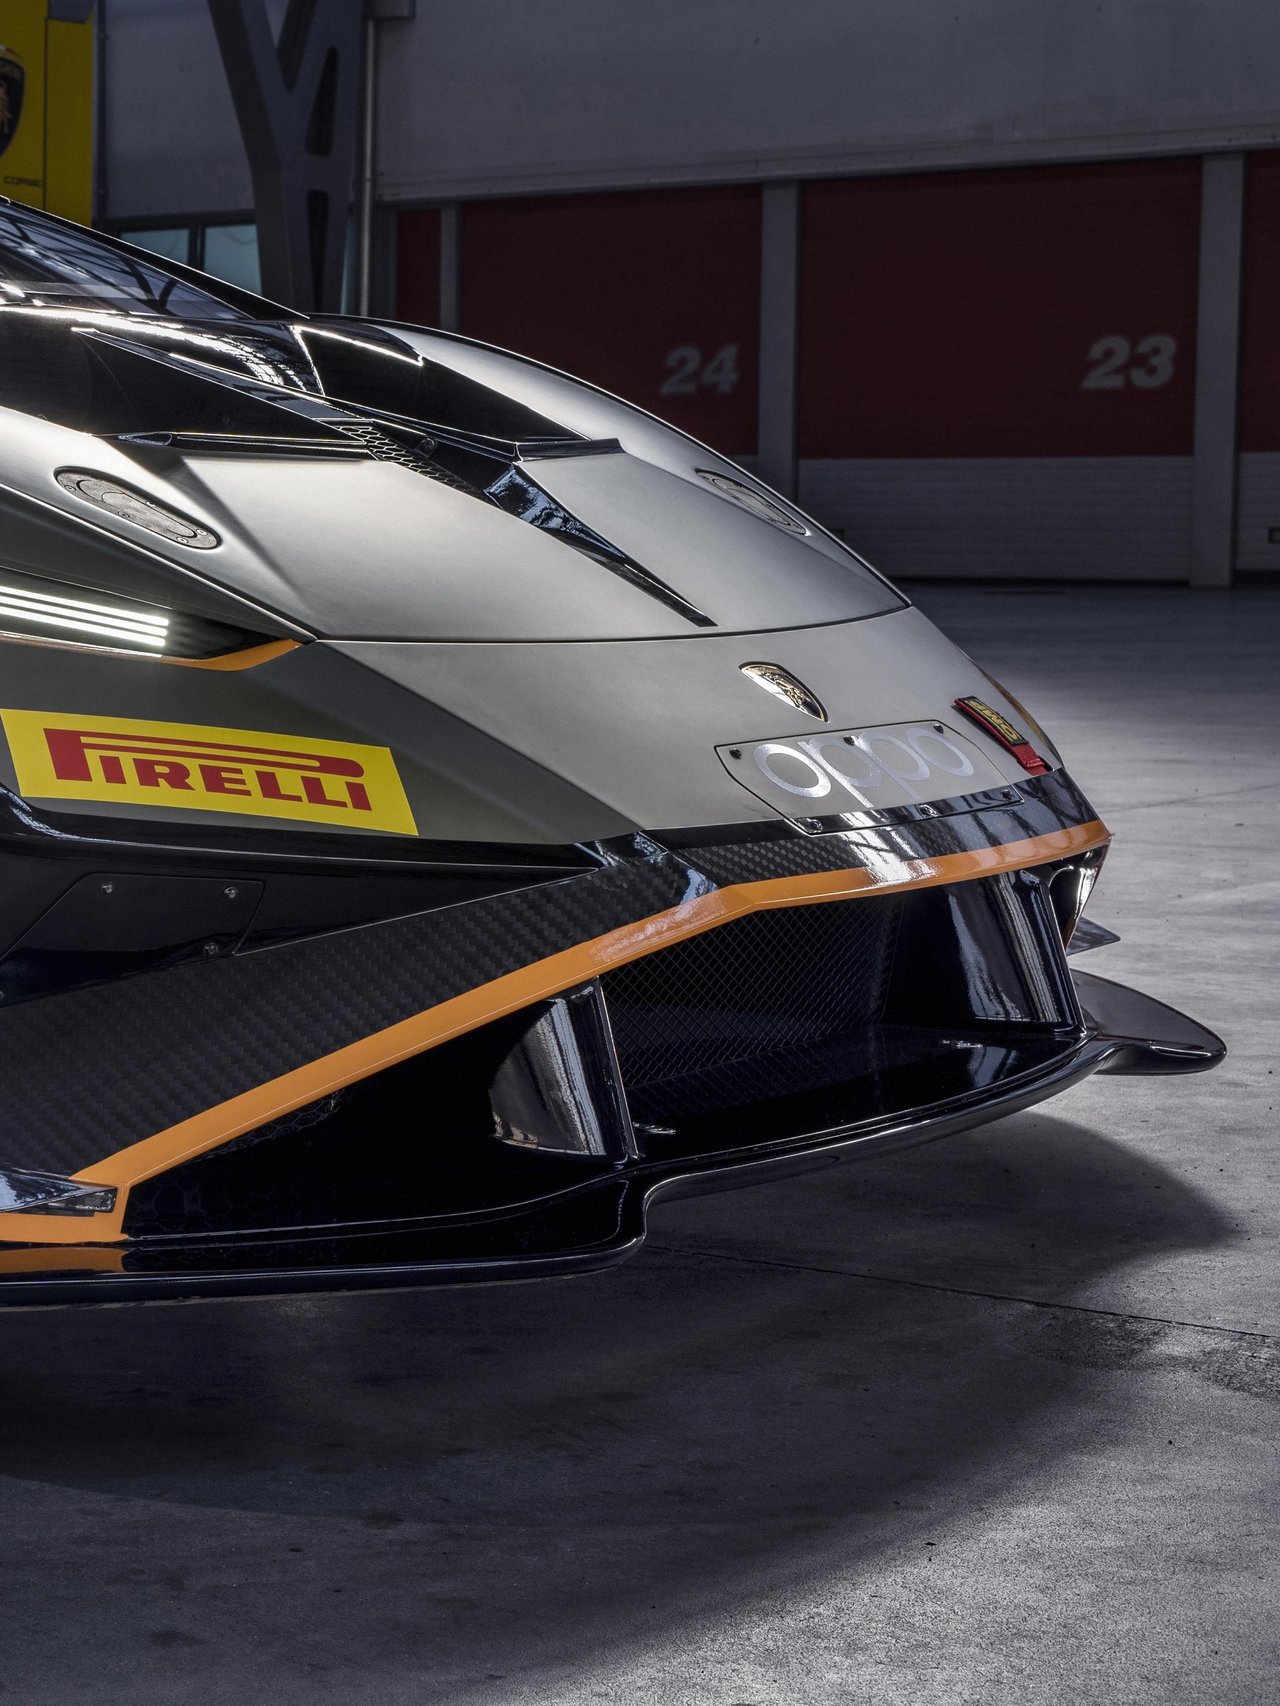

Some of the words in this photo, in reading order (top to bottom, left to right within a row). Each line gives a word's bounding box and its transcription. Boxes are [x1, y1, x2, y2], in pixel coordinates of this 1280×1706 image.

[661, 343, 741, 396] 24
[1080, 333, 1178, 391] 23
[43, 728, 372, 811] PIRELLI
[753, 726, 975, 809] oppo
